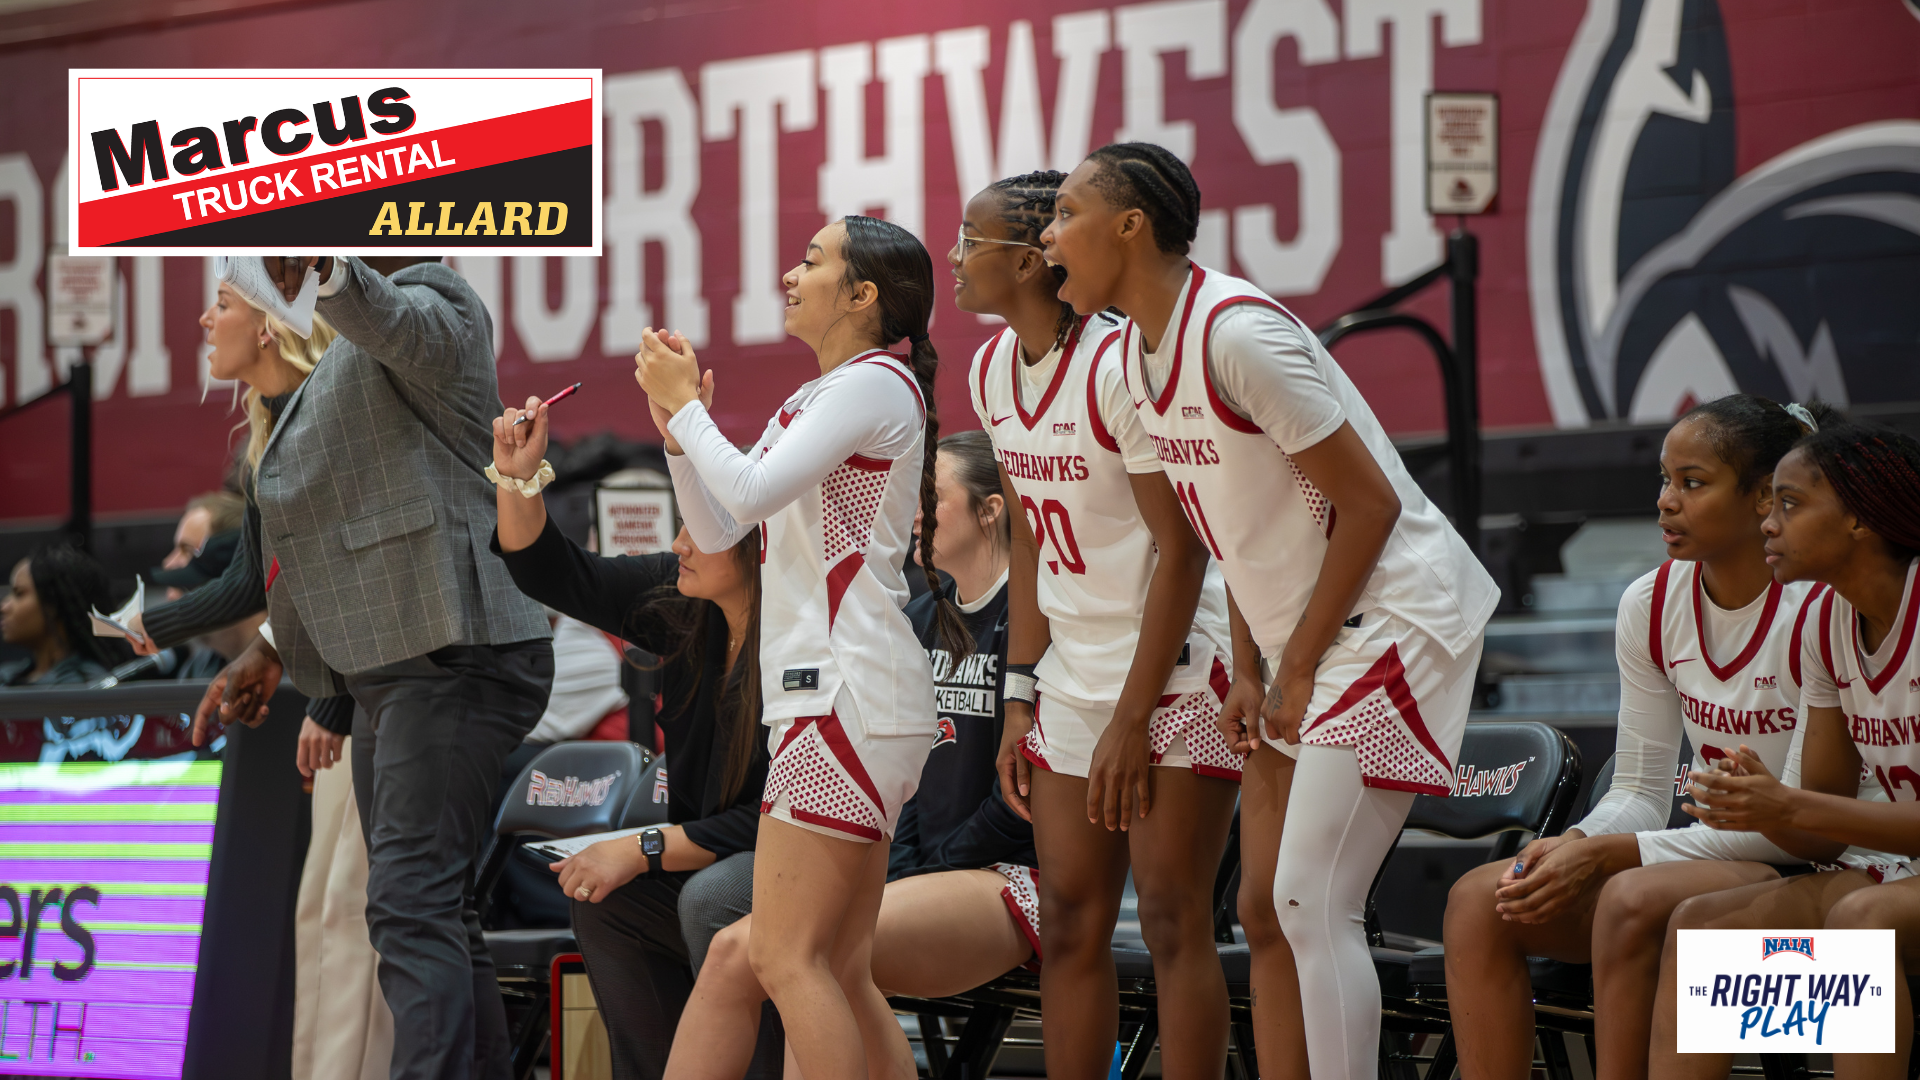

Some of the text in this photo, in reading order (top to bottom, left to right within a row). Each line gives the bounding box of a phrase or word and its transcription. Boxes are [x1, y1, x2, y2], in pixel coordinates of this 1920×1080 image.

[998, 448, 1089, 482] EDHAWKS
[1176, 481, 1224, 561] 11
[805, 675, 812, 683] S
[1675, 686, 1797, 735] EDHAWKS
[1449, 761, 1527, 797] HAWKS
